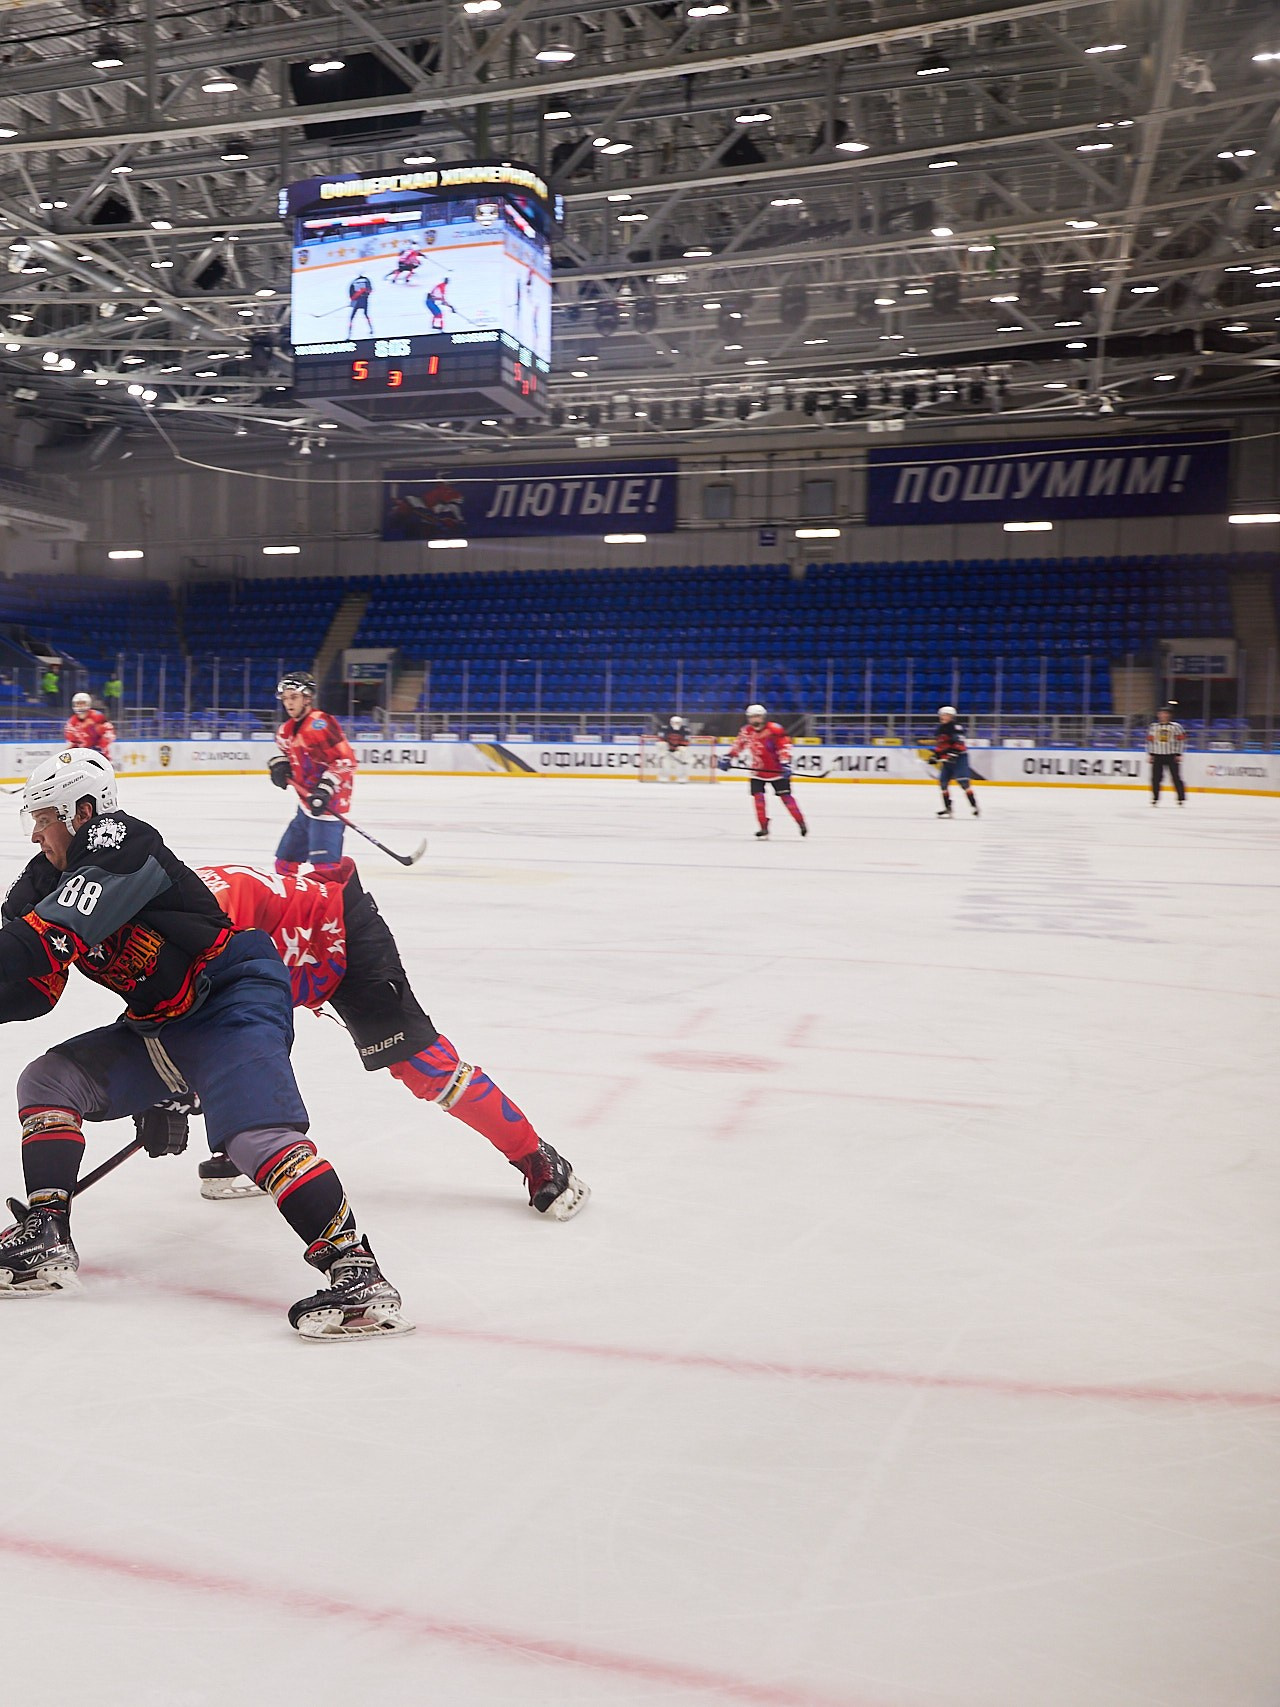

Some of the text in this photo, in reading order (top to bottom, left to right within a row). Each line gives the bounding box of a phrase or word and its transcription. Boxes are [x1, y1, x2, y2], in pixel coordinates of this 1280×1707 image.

[352, 360, 369, 380] 5
[428, 355, 439, 375] 1
[387, 370, 403, 387] 3
[892, 454, 1193, 504] ПОШУМИМ!
[486, 478, 663, 518] ЛЮТЫЕ!
[1023, 757, 1141, 778] OHLIGA.RU
[57, 873, 103, 917] 88
